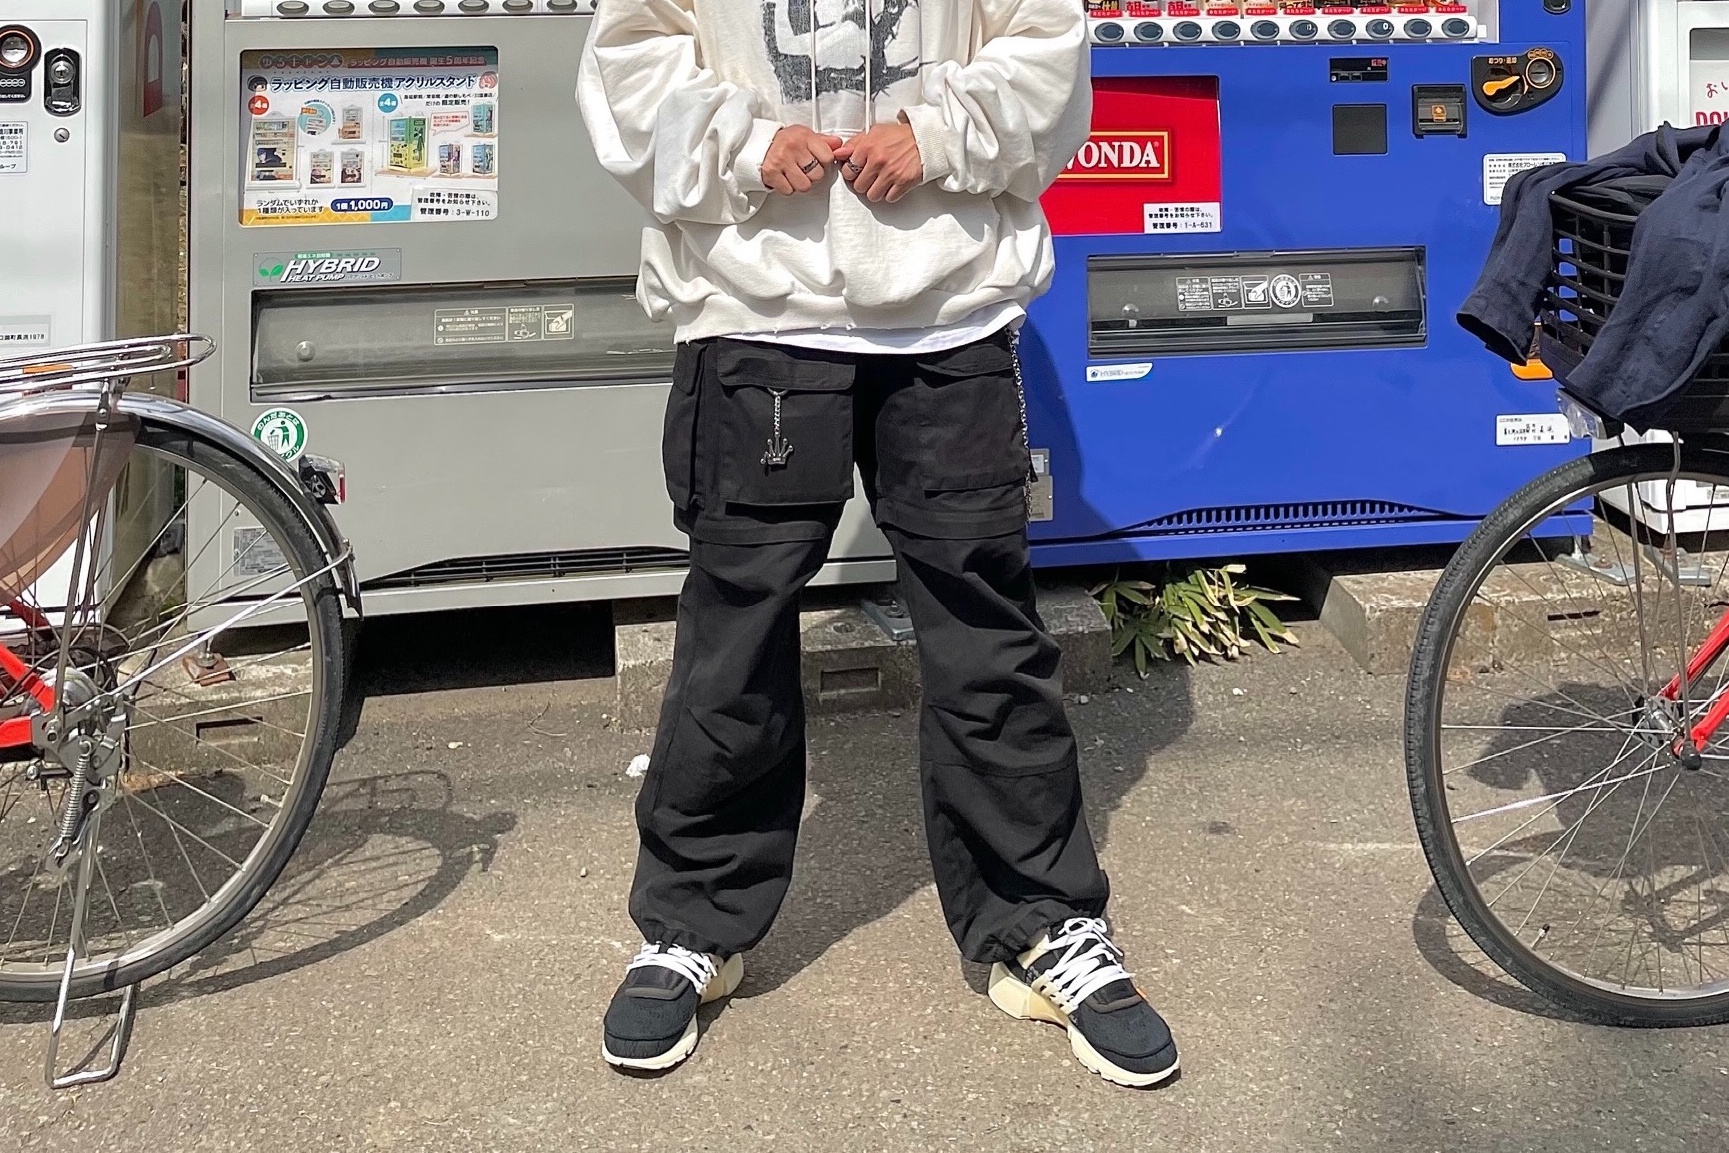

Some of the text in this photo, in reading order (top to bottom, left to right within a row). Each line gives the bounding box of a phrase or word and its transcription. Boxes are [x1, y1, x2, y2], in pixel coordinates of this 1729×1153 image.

[280, 257, 381, 282] HYBRID
[316, 273, 345, 281] PUMP
[257, 411, 300, 431] のんだあとは
